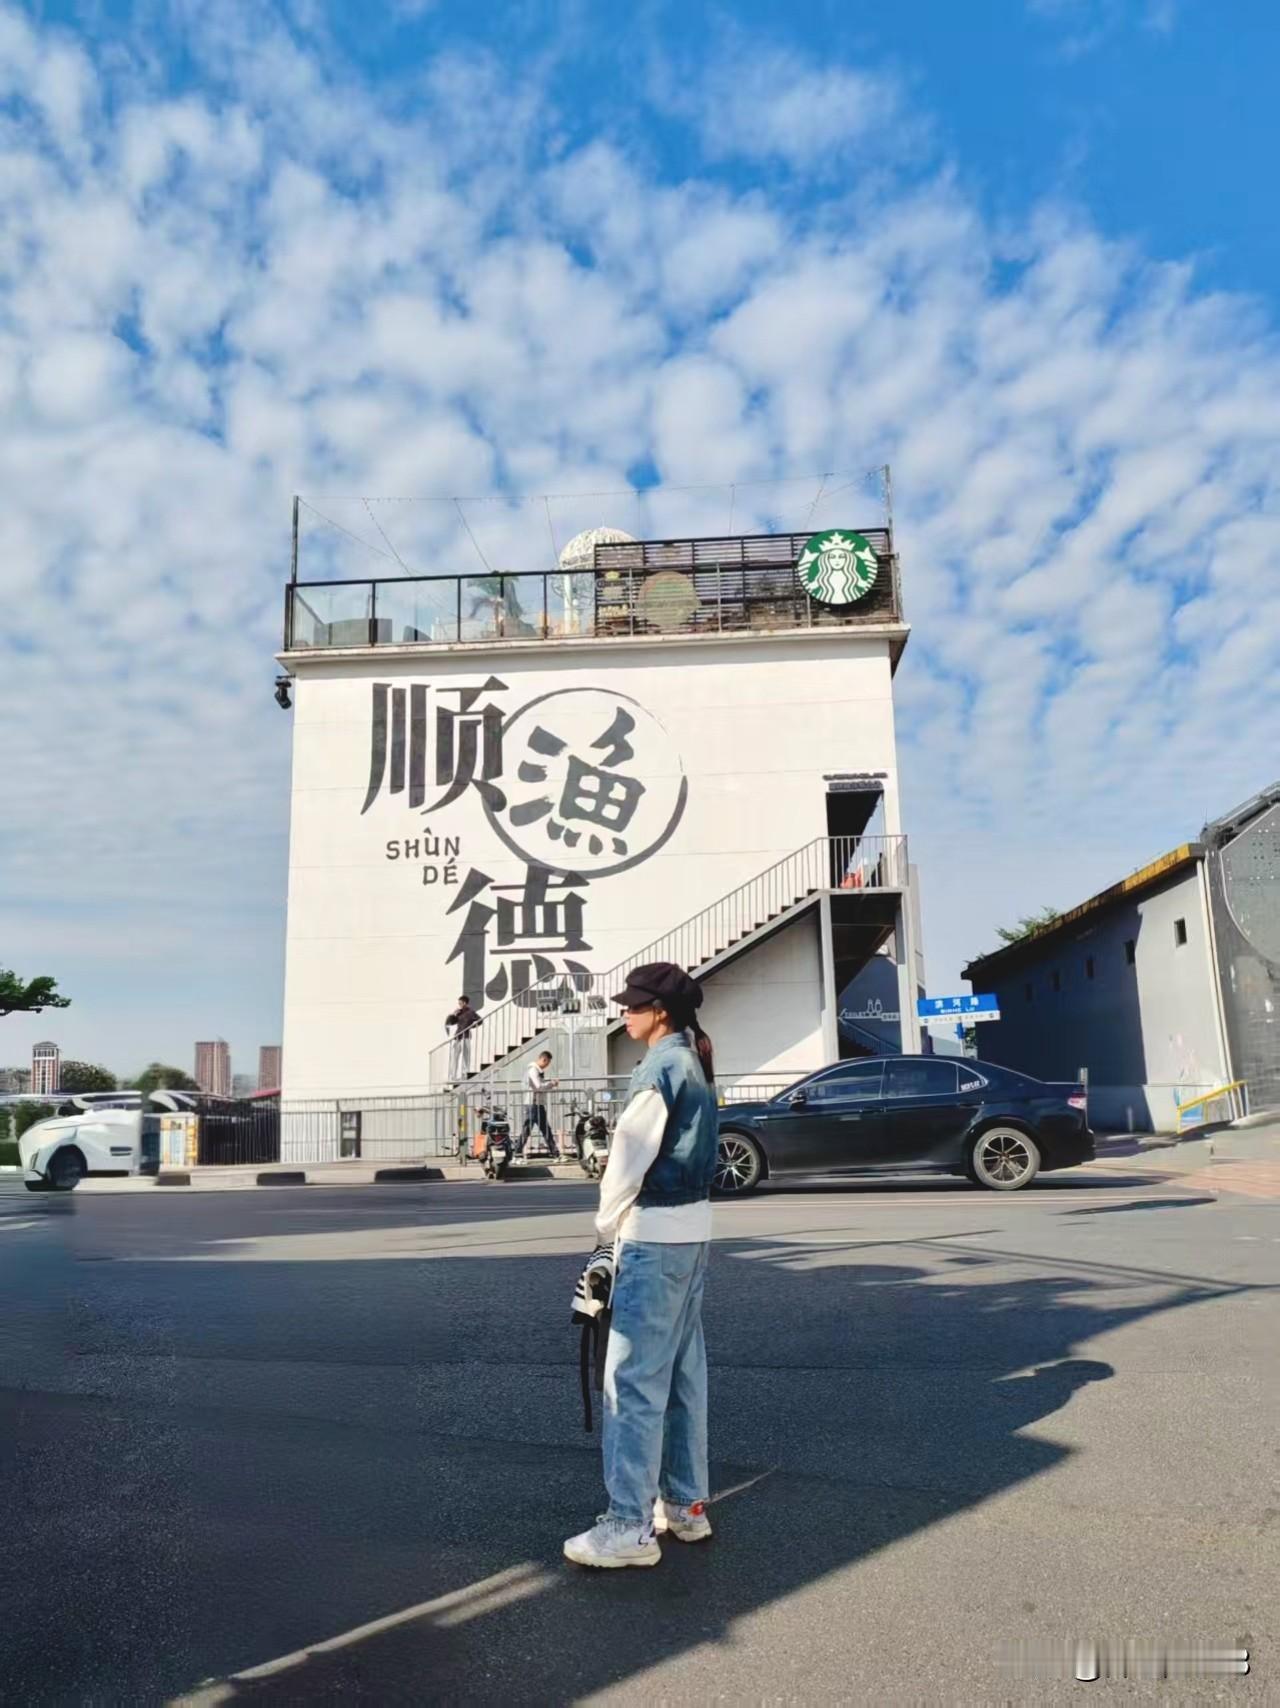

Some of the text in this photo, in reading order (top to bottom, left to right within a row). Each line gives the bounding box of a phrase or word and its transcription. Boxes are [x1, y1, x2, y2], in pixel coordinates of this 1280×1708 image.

[360, 675, 509, 816] 顺
[422, 857, 459, 886] DÉ
[445, 865, 594, 1012] 德
